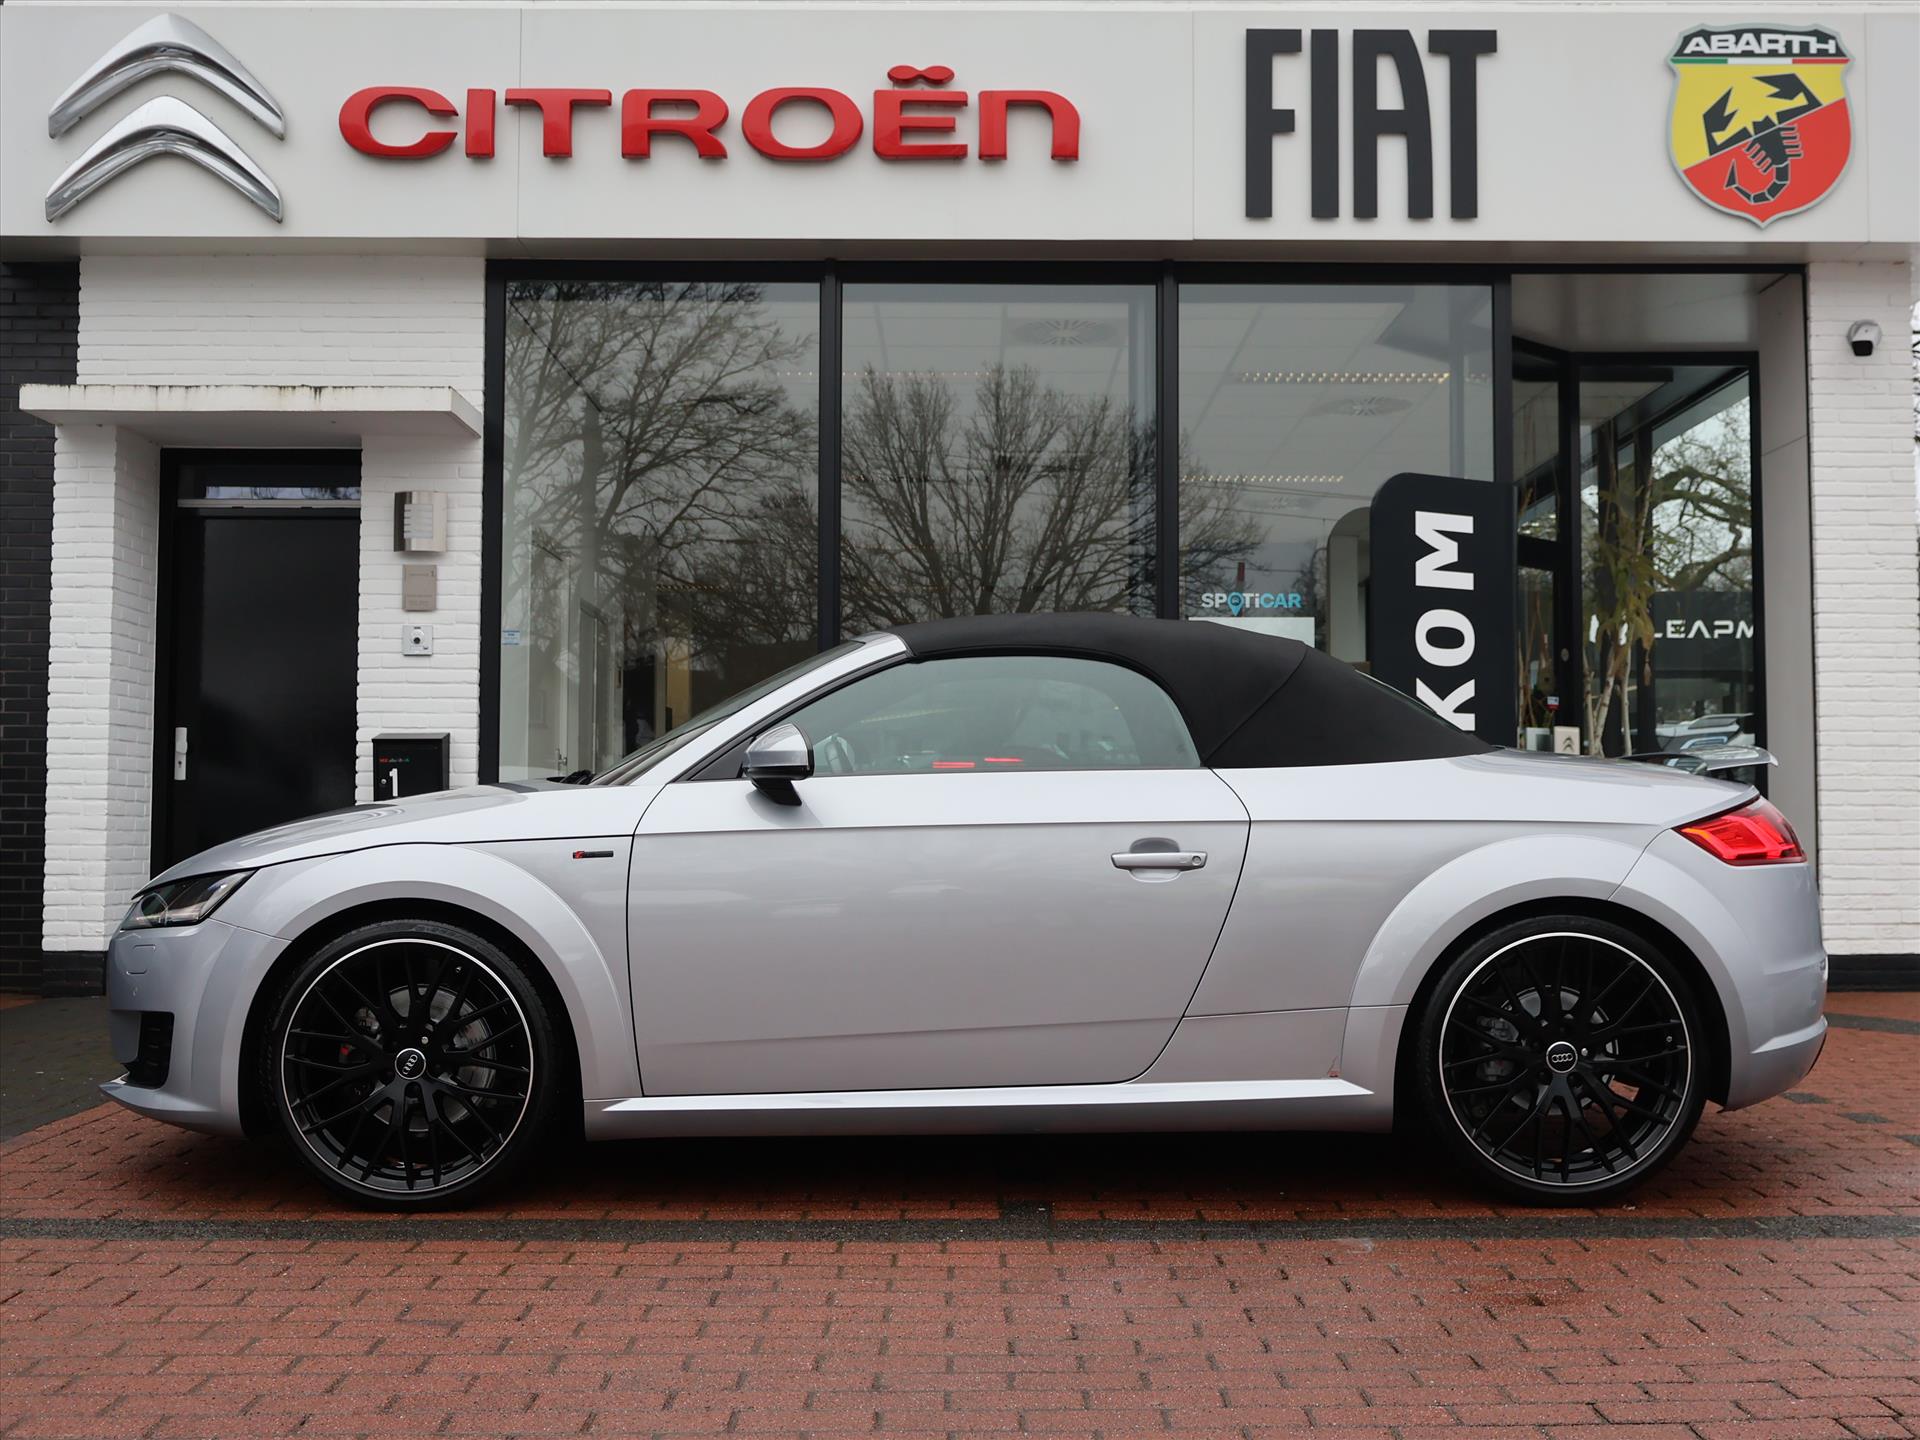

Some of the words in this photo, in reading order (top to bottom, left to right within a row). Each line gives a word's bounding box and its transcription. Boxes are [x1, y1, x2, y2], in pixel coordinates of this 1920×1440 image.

[1683, 33, 1836, 54] ABARTH
[1246, 29, 1497, 222] FIAT
[389, 768, 398, 797] 1
